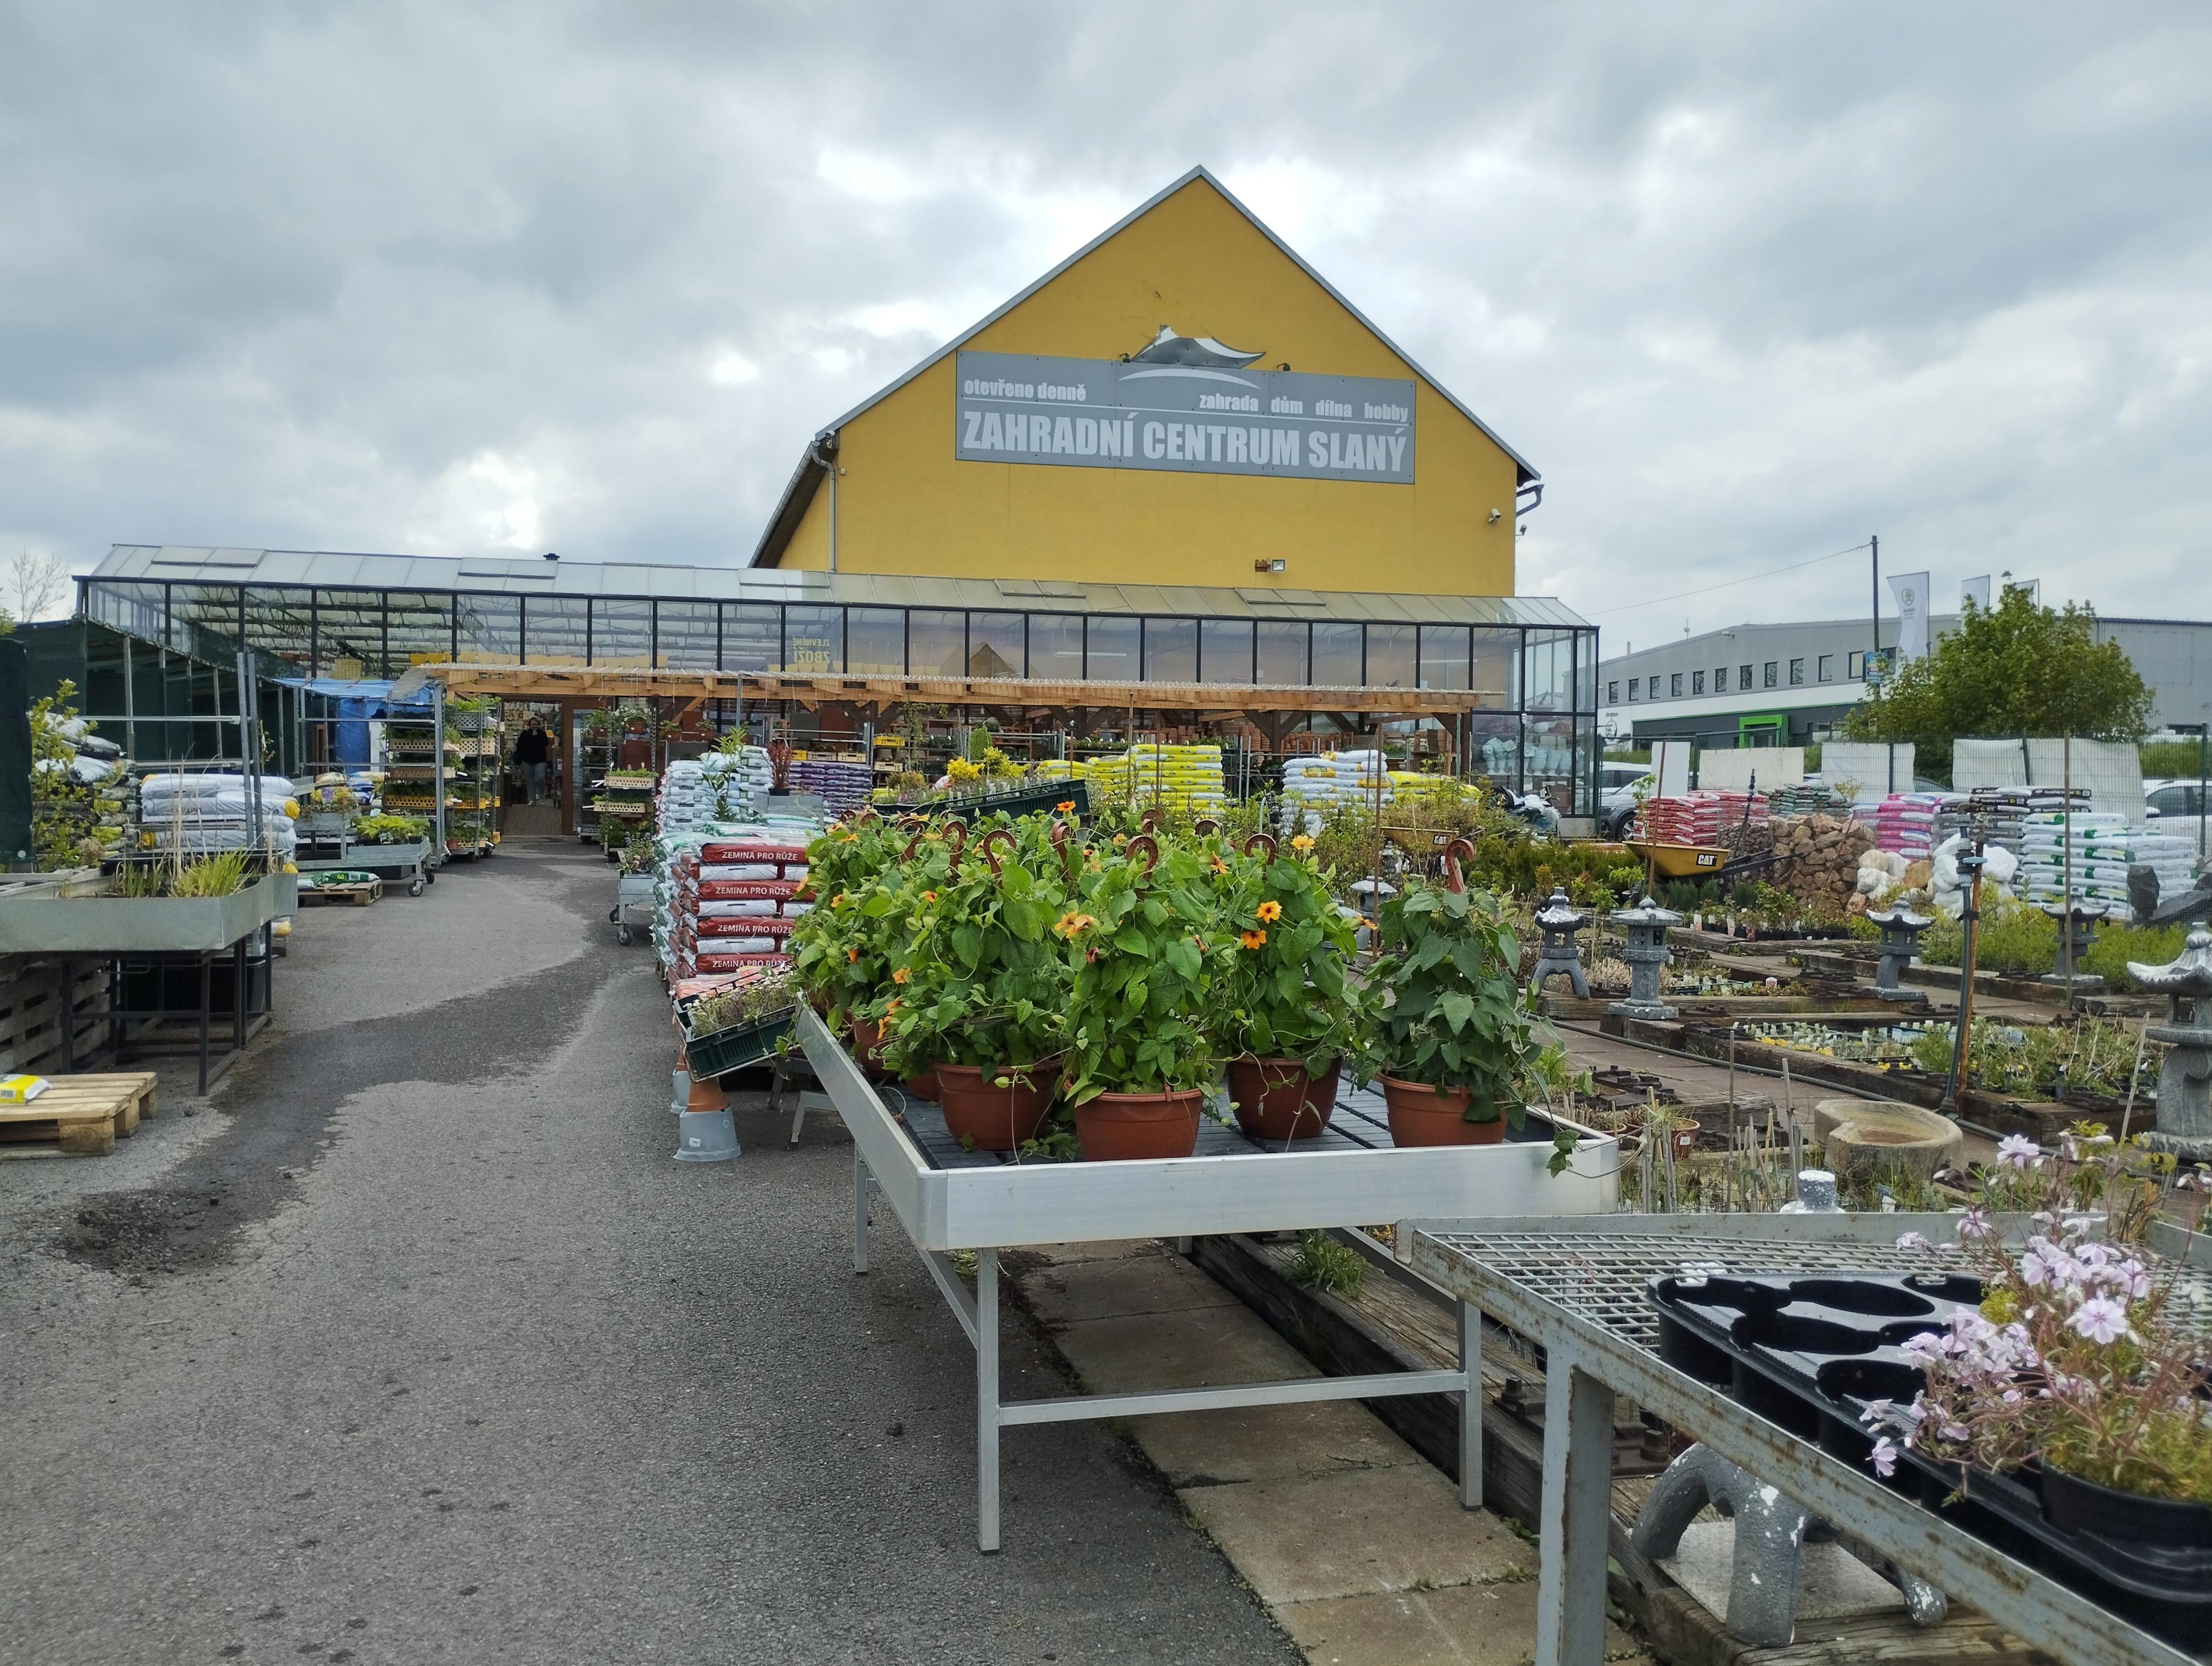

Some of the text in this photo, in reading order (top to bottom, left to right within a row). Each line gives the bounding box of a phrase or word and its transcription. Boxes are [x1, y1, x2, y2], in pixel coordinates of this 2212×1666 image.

[964, 379, 1087, 402] otevřeno denně
[1199, 393, 1409, 422] zahrada dům dílna hobby
[963, 411, 1407, 471] ZAHRADNÍ CENTRUM SLANÝ
[1434, 835, 1447, 844] CAT
[776, 851, 798, 861] RŮŽE
[1698, 855, 1714, 865] CAT
[770, 886, 791, 895] RŮŽE
[717, 925, 793, 934] ZEMINA PRO RŮŽE
[712, 960, 745, 968] ZEMINA
